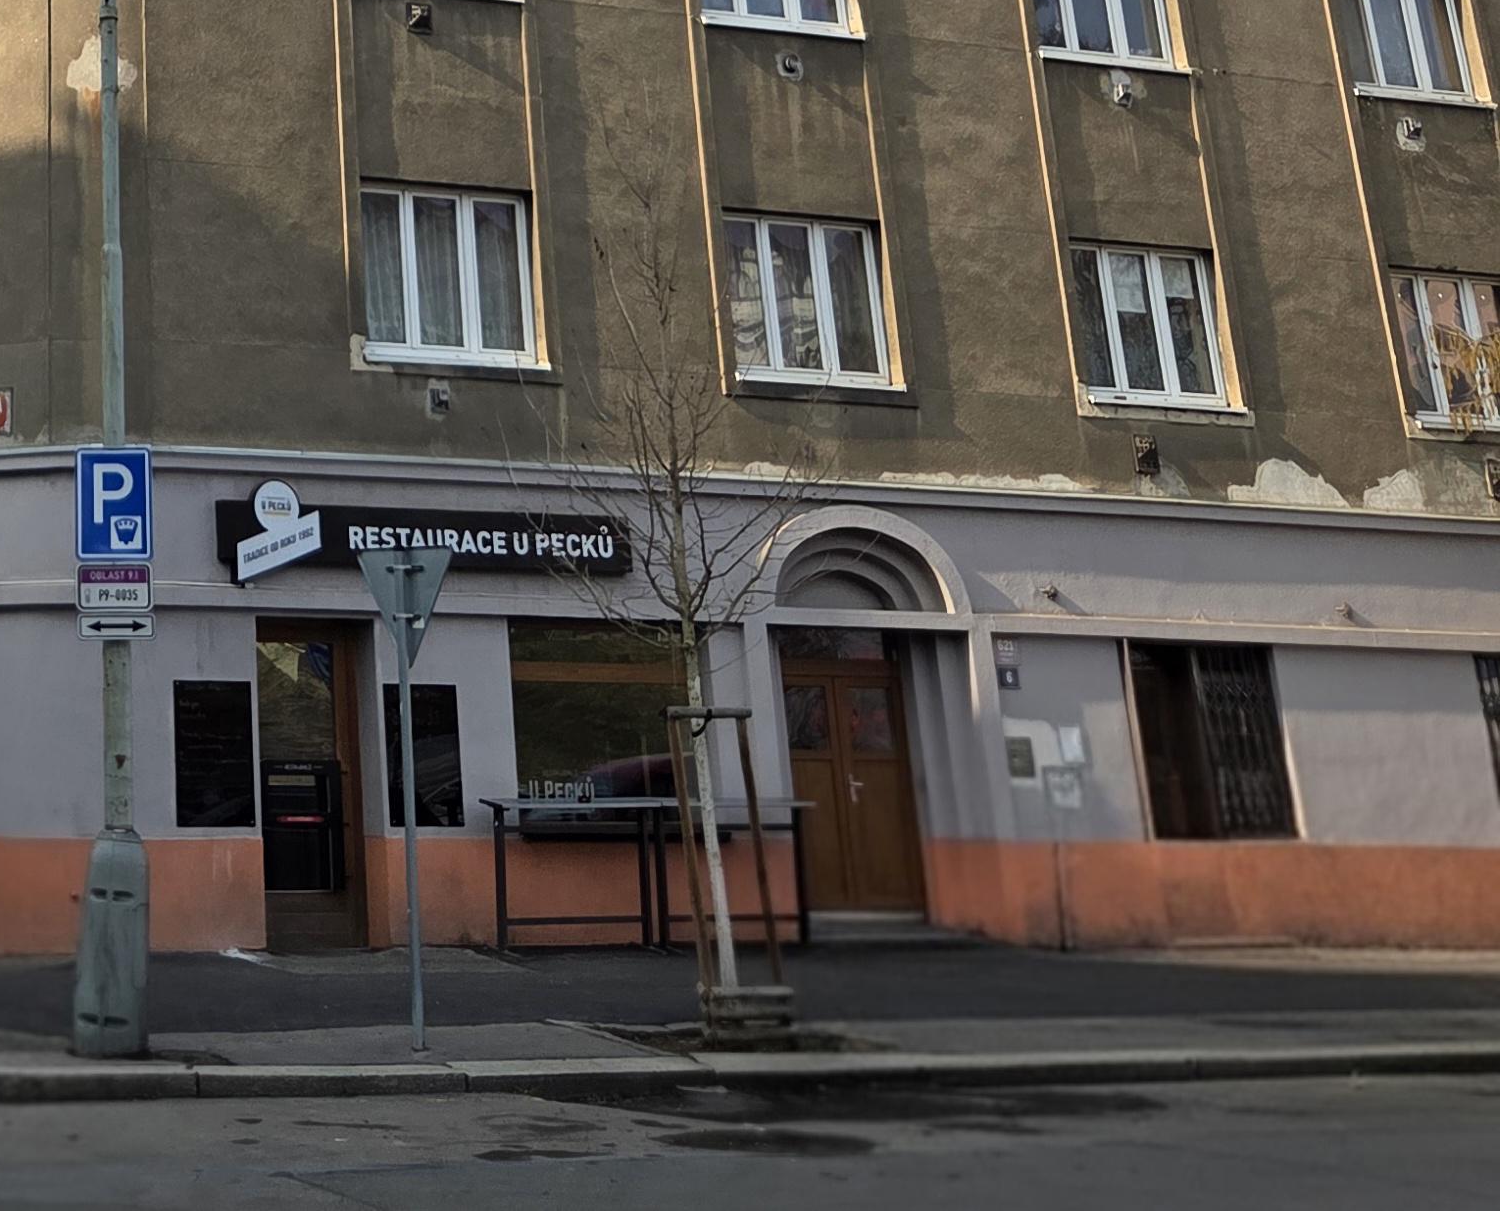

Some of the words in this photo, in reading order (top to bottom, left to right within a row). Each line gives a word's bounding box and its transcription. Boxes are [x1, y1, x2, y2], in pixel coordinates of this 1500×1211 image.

[93, 463, 133, 524] P
[349, 525, 507, 555] RESTAURACE
[513, 531, 529, 555] U
[535, 525, 614, 558] PECKŮ
[90, 570, 124, 580] OBLAST
[1006, 671, 1013, 683] 6
